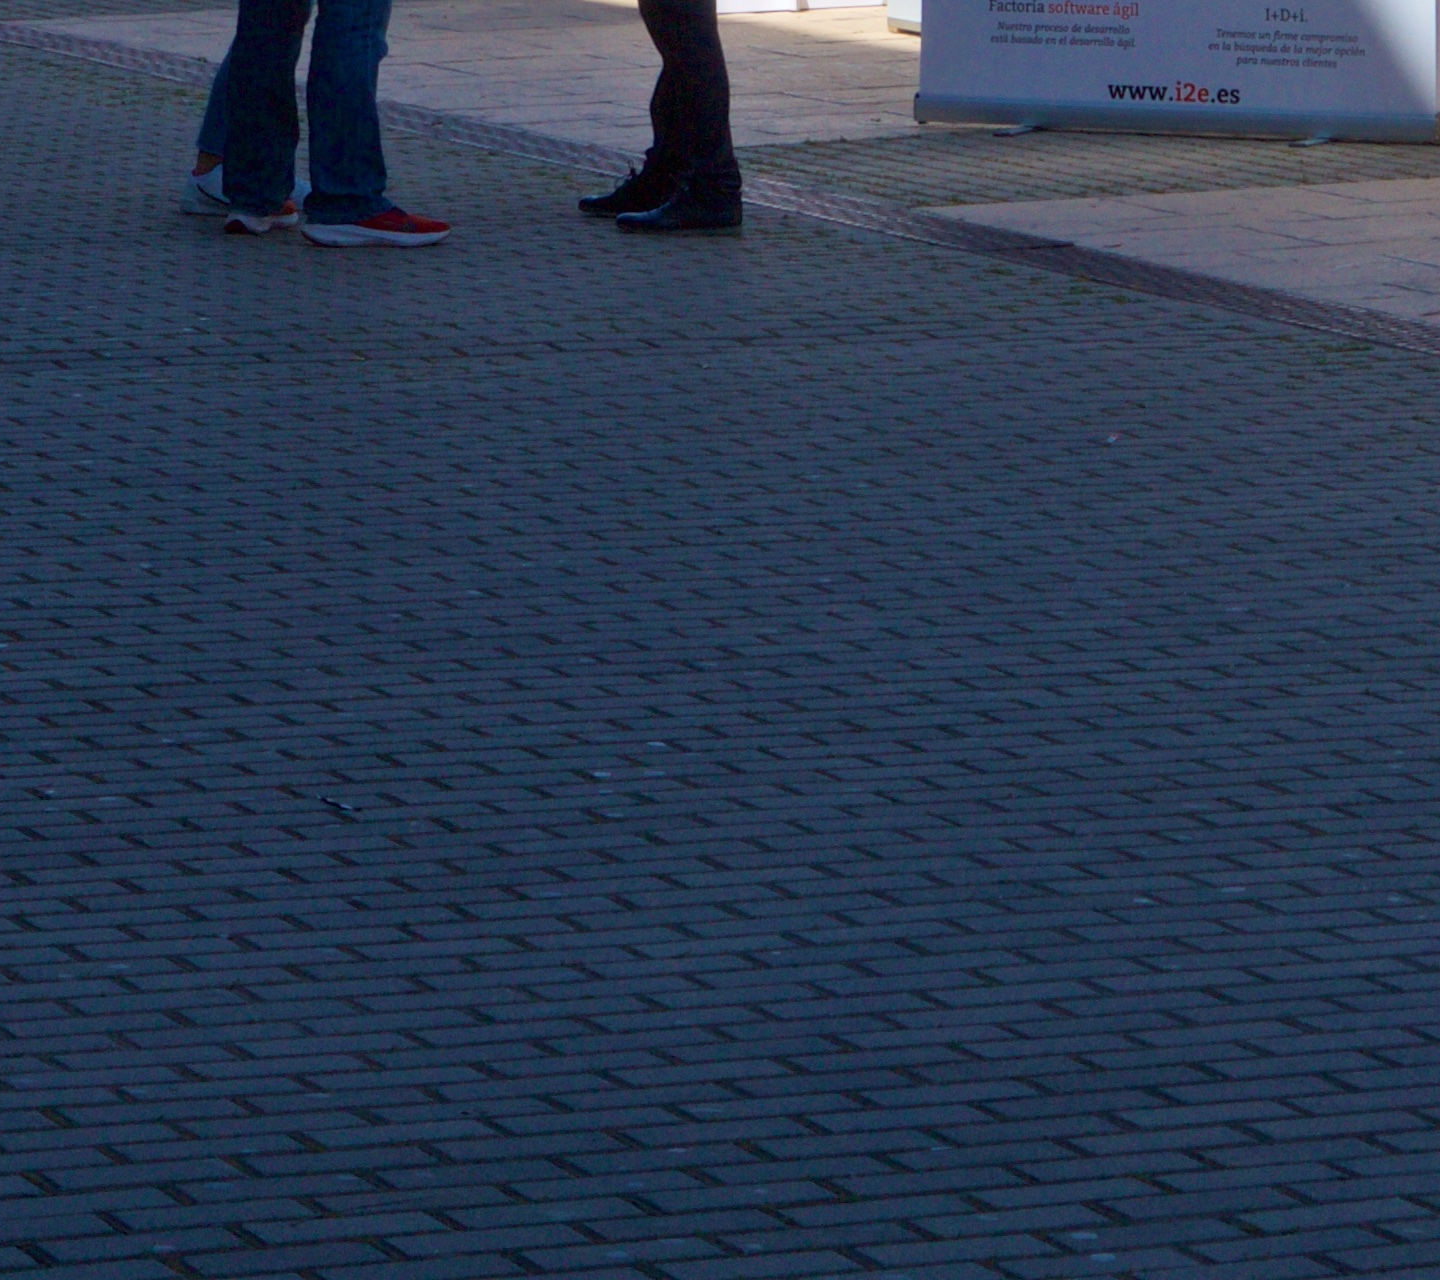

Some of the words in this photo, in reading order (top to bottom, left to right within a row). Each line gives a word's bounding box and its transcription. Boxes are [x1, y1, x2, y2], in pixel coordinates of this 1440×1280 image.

[1048, 0, 1111, 16] software
[1113, 2, 1140, 20] ágil
[1107, 80, 1241, 105] www.i2e.es
